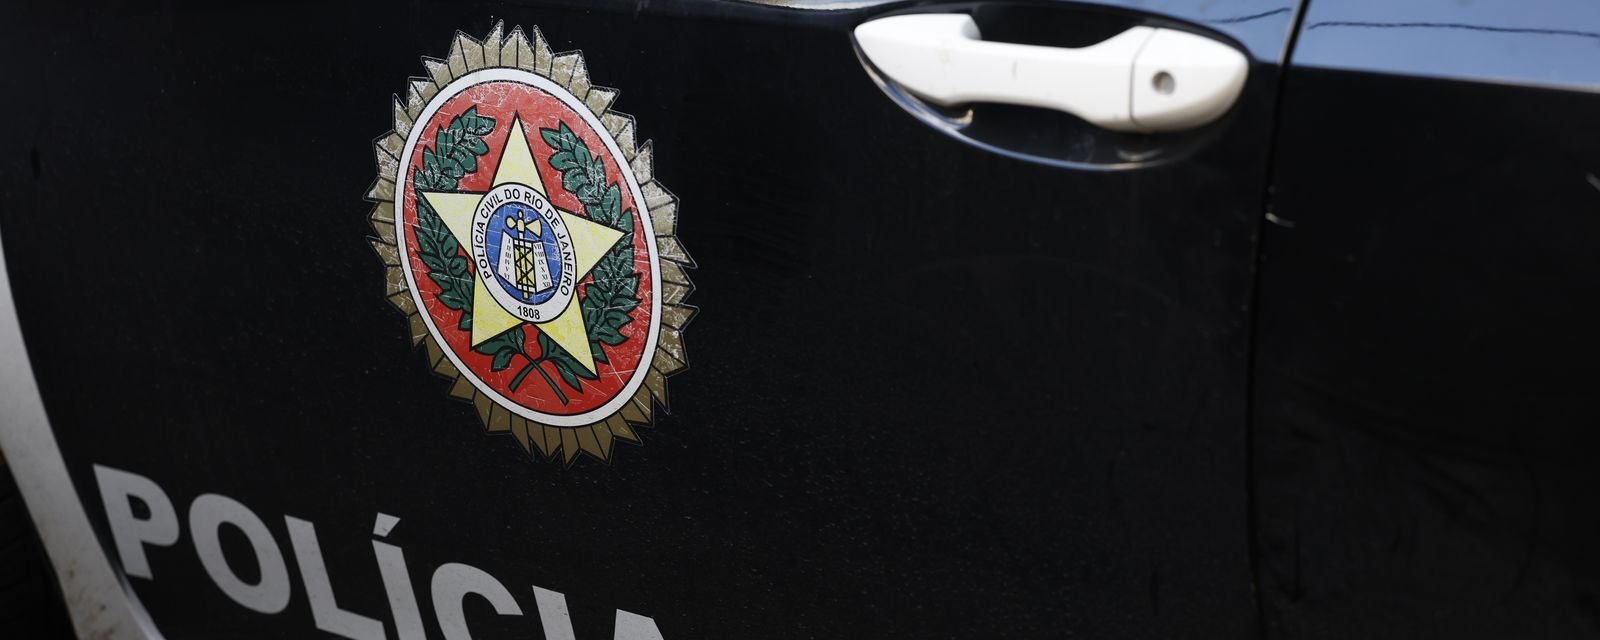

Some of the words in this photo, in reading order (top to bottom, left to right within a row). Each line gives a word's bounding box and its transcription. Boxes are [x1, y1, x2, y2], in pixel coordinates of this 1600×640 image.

[504, 188, 521, 200] DO
[524, 191, 543, 210] RIO
[481, 193, 504, 219] CIVIL
[545, 208, 560, 229] DE
[474, 221, 492, 279] POLÍCIA
[557, 232, 573, 296] JANEIRO
[516, 305, 541, 320] 1808
[93, 463, 665, 640] POLÍCI
